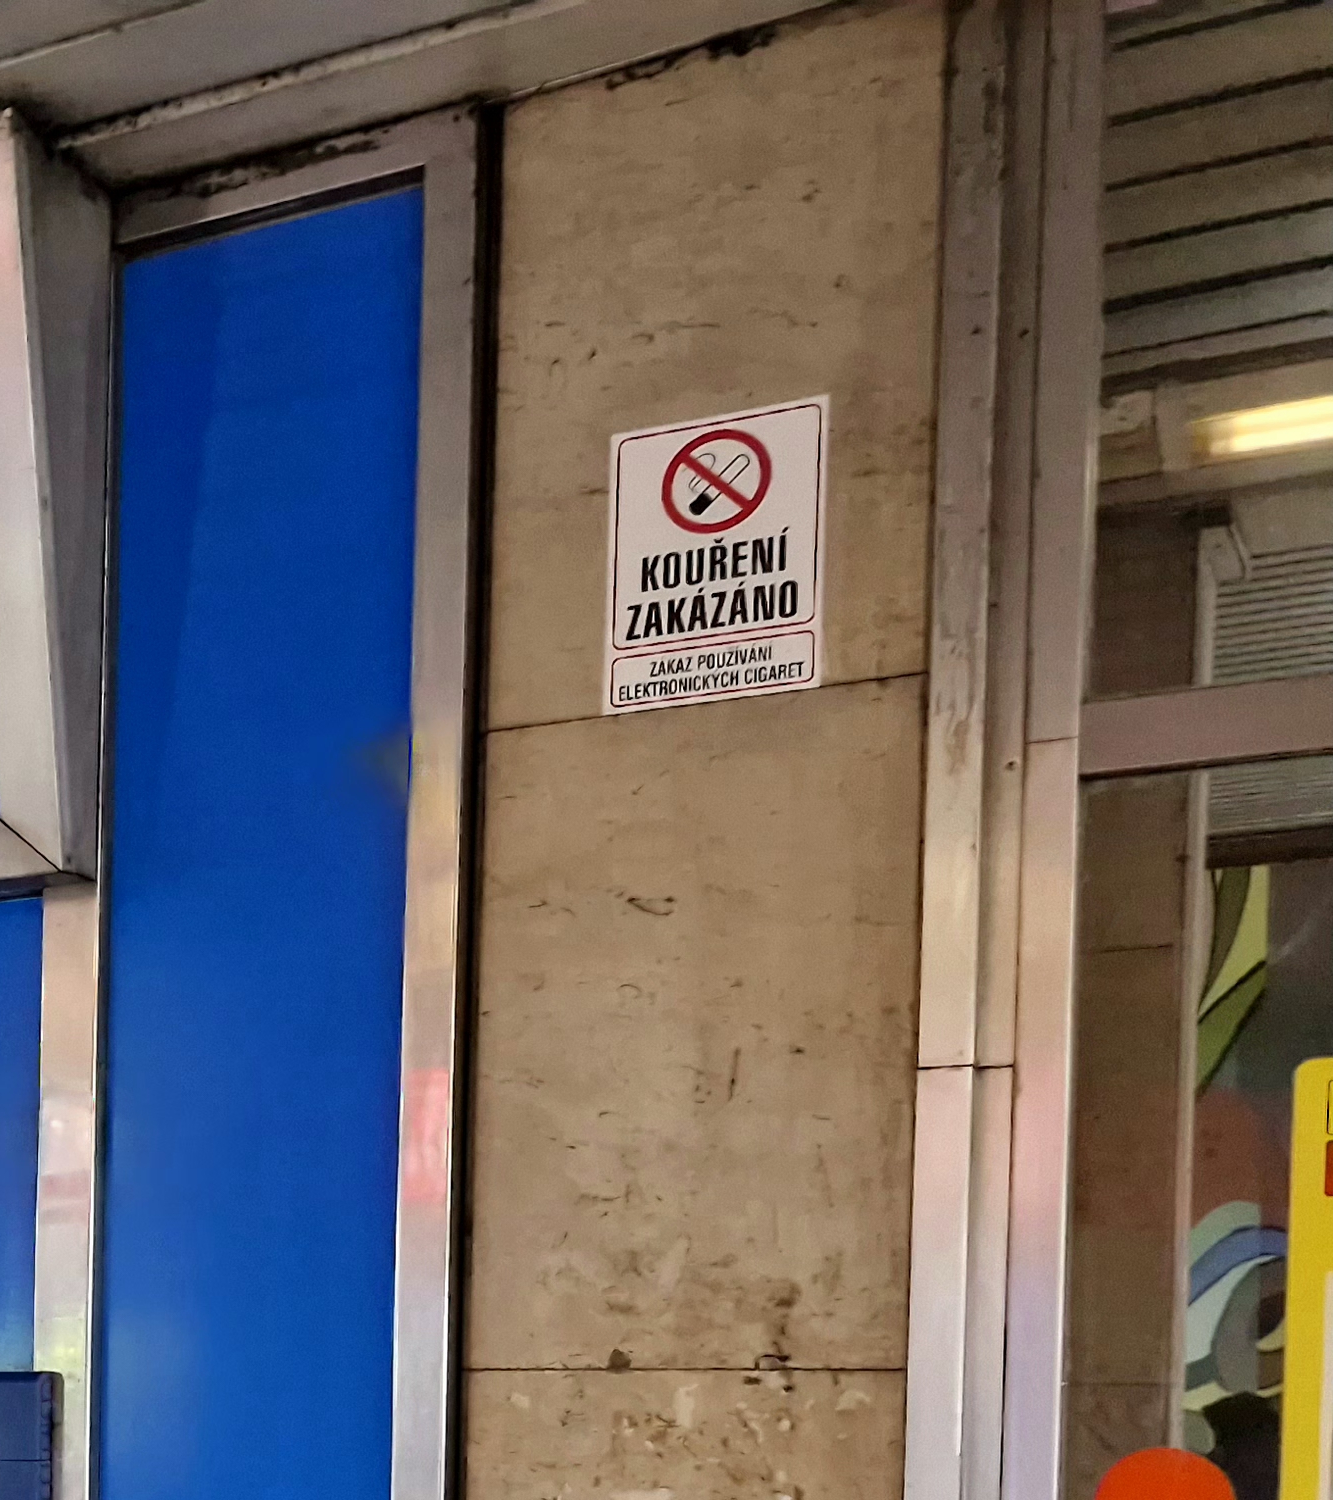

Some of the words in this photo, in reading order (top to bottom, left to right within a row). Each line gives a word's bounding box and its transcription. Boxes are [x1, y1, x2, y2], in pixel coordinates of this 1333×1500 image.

[640, 526, 790, 593] KOUŘENÍ
[625, 580, 799, 642] ZAKÁZÁNO
[618, 667, 740, 702] ELEKTRONICKÝCH
[744, 660, 805, 685] CIGARET
